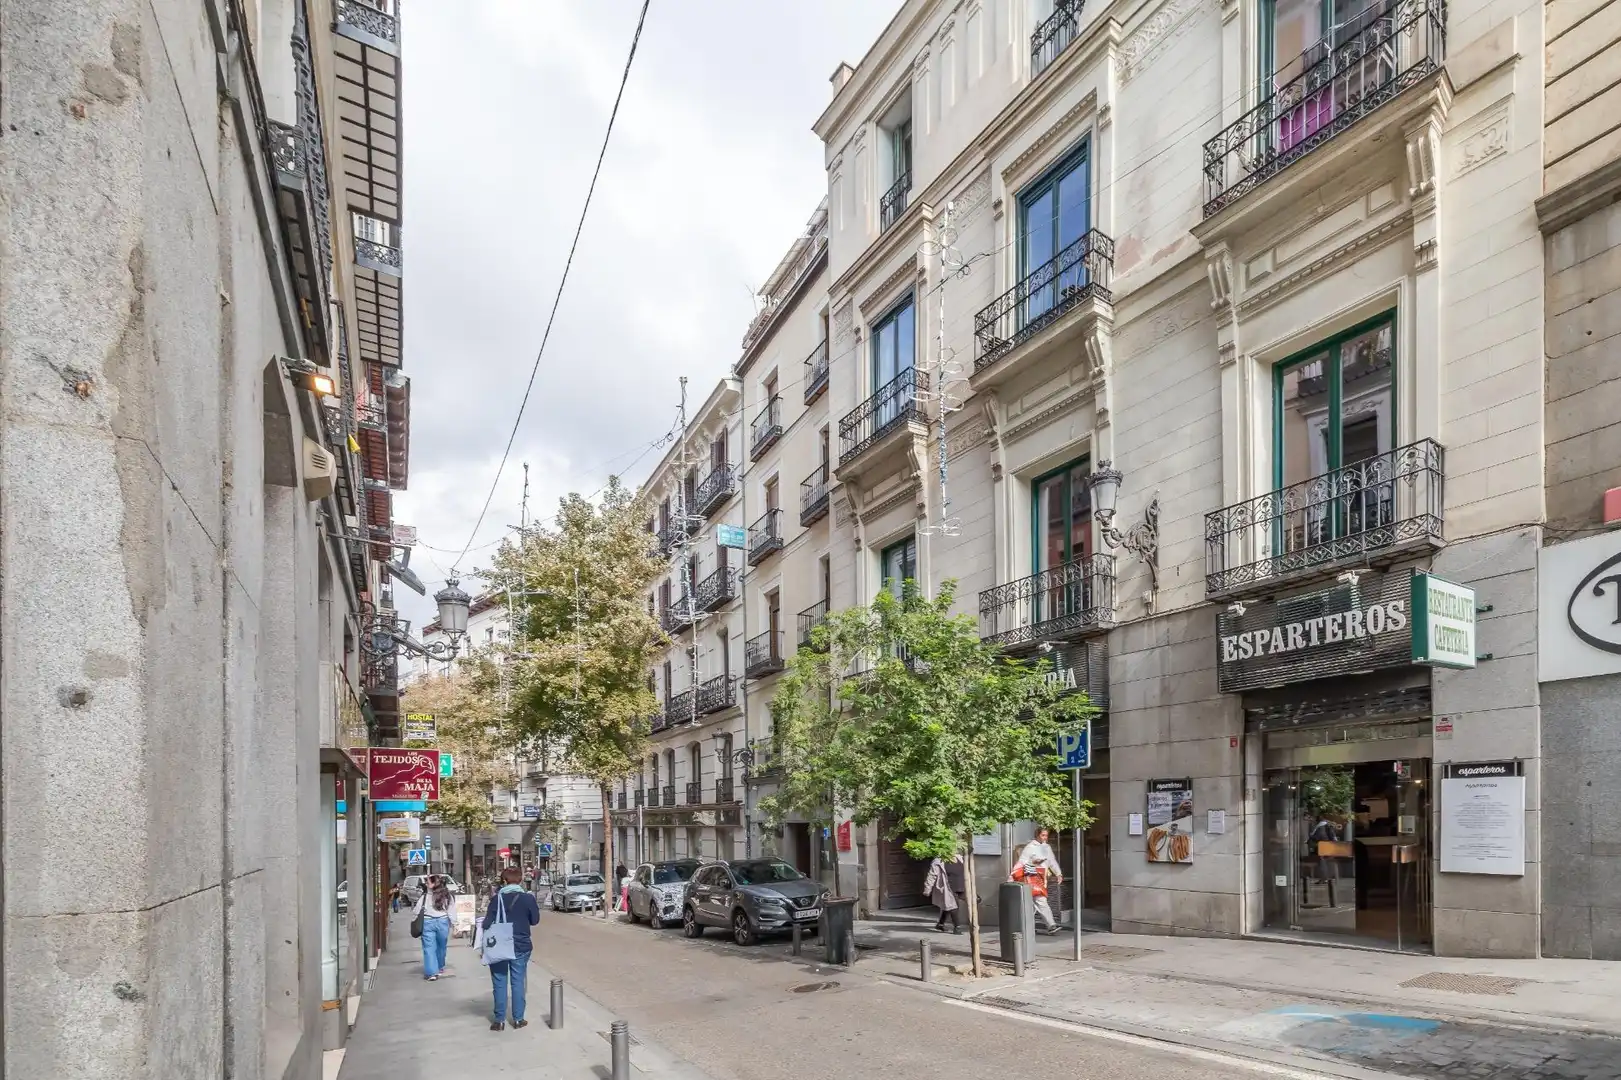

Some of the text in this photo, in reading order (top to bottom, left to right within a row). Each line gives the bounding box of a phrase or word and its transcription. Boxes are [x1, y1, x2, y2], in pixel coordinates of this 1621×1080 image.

[1220, 599, 1406, 663] ESPARTEROS
[407, 713, 434, 721] HOSTAL
[1061, 728, 1080, 764] P
[373, 755, 418, 764] TEJIDOS
[1458, 765, 1506, 776] esparteros
[404, 783, 434, 791] MAJA
